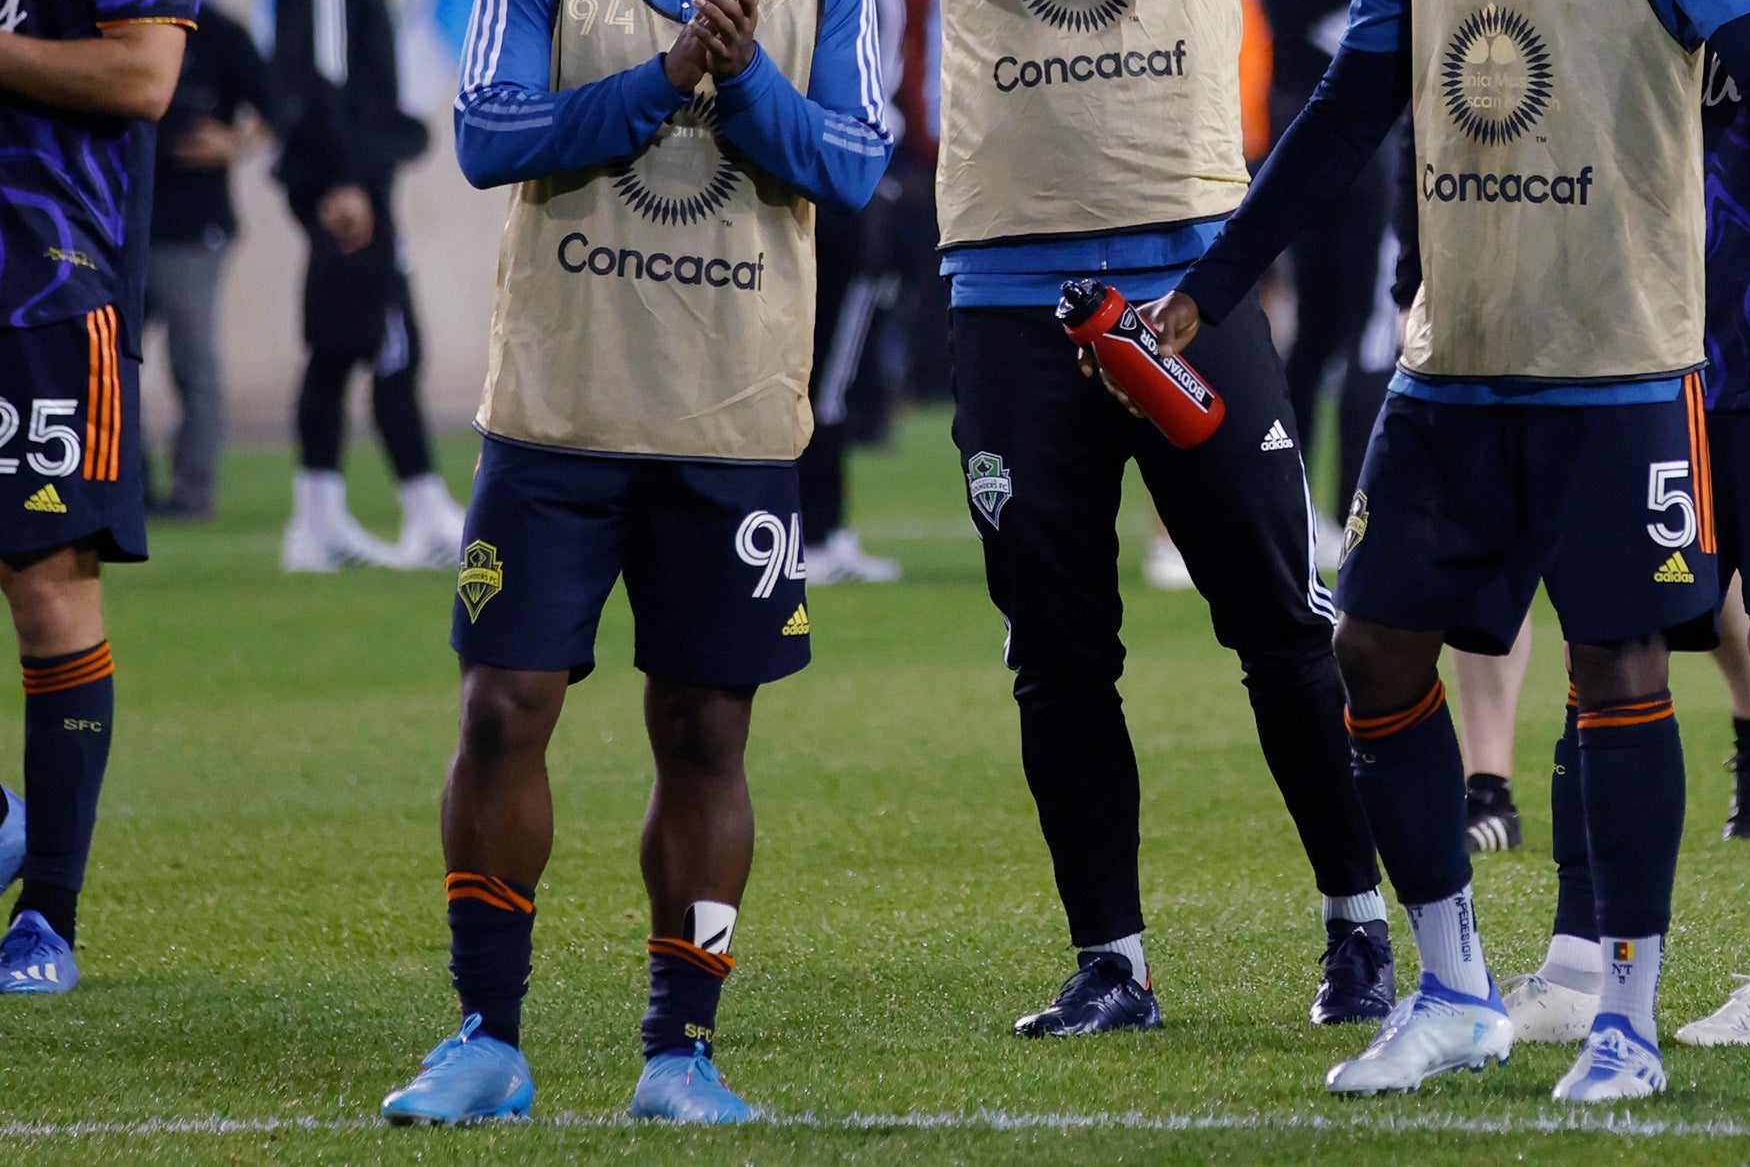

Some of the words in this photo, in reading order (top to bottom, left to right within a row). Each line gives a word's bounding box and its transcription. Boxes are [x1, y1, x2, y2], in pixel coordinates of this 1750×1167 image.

[993, 39, 1187, 93] Concacaf
[1422, 163, 1593, 206] Concacaf
[557, 232, 765, 292] Concacaf
[1138, 329, 1206, 403] BODYAROR
[1260, 437, 1294, 452] adidas
[1647, 460, 1697, 548] 5
[1653, 570, 1695, 584] adidas
[782, 623, 810, 636] adida
[63, 718, 102, 732] SFC
[1612, 963, 1633, 975] NT
